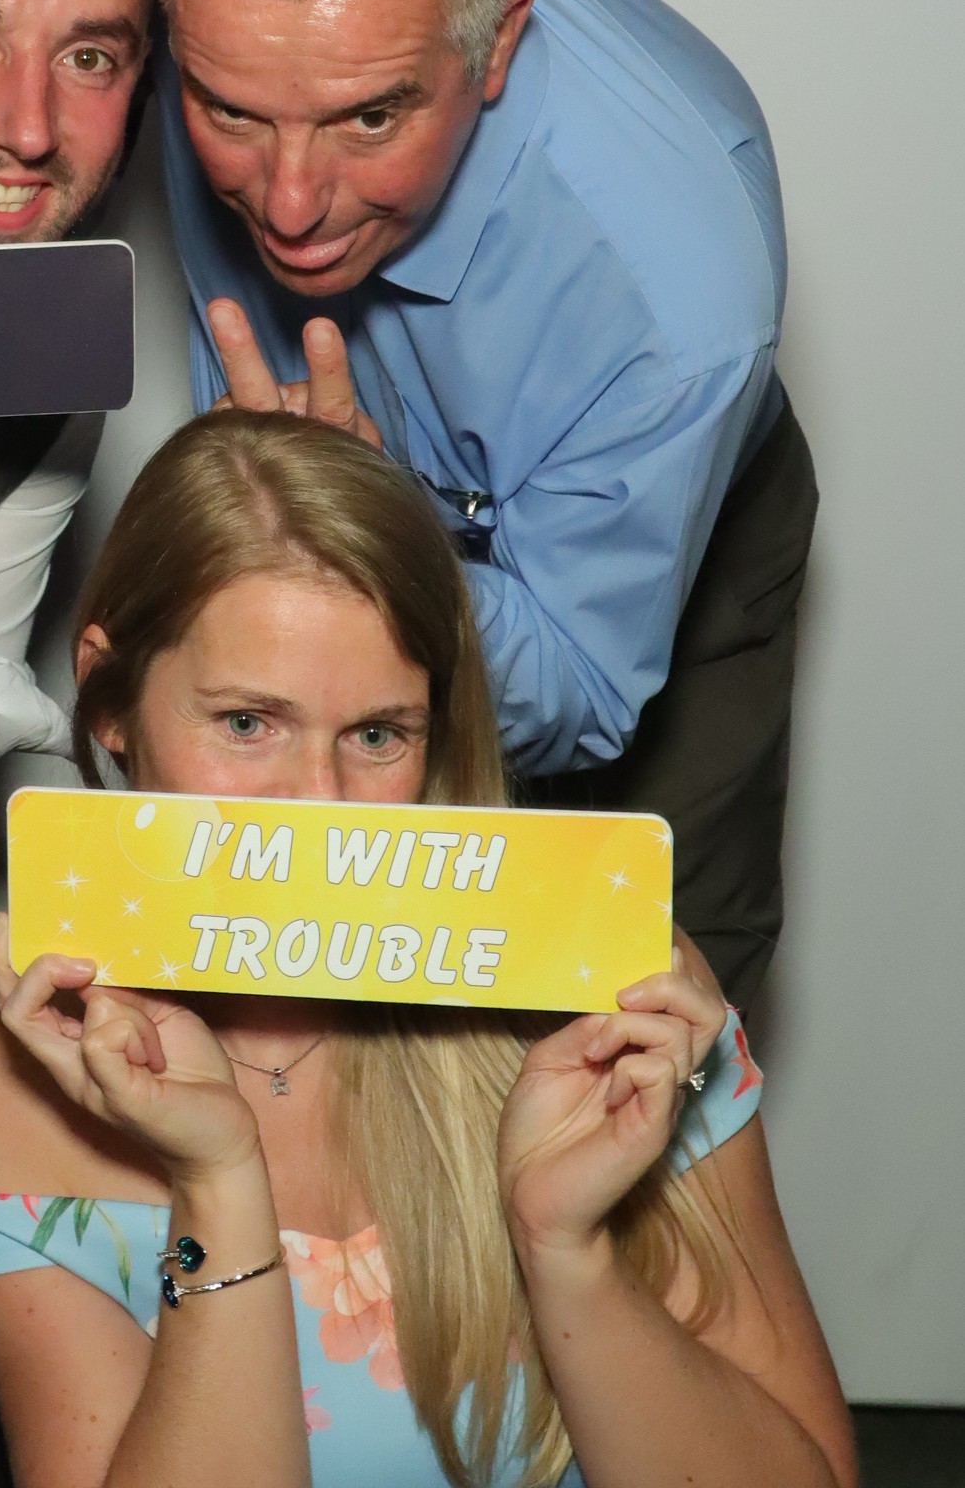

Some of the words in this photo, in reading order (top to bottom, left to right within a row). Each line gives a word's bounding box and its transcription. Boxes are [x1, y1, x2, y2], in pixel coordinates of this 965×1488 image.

[182, 820, 294, 883] I'M
[325, 826, 507, 892] WITH
[188, 914, 508, 988] TROUBLE
